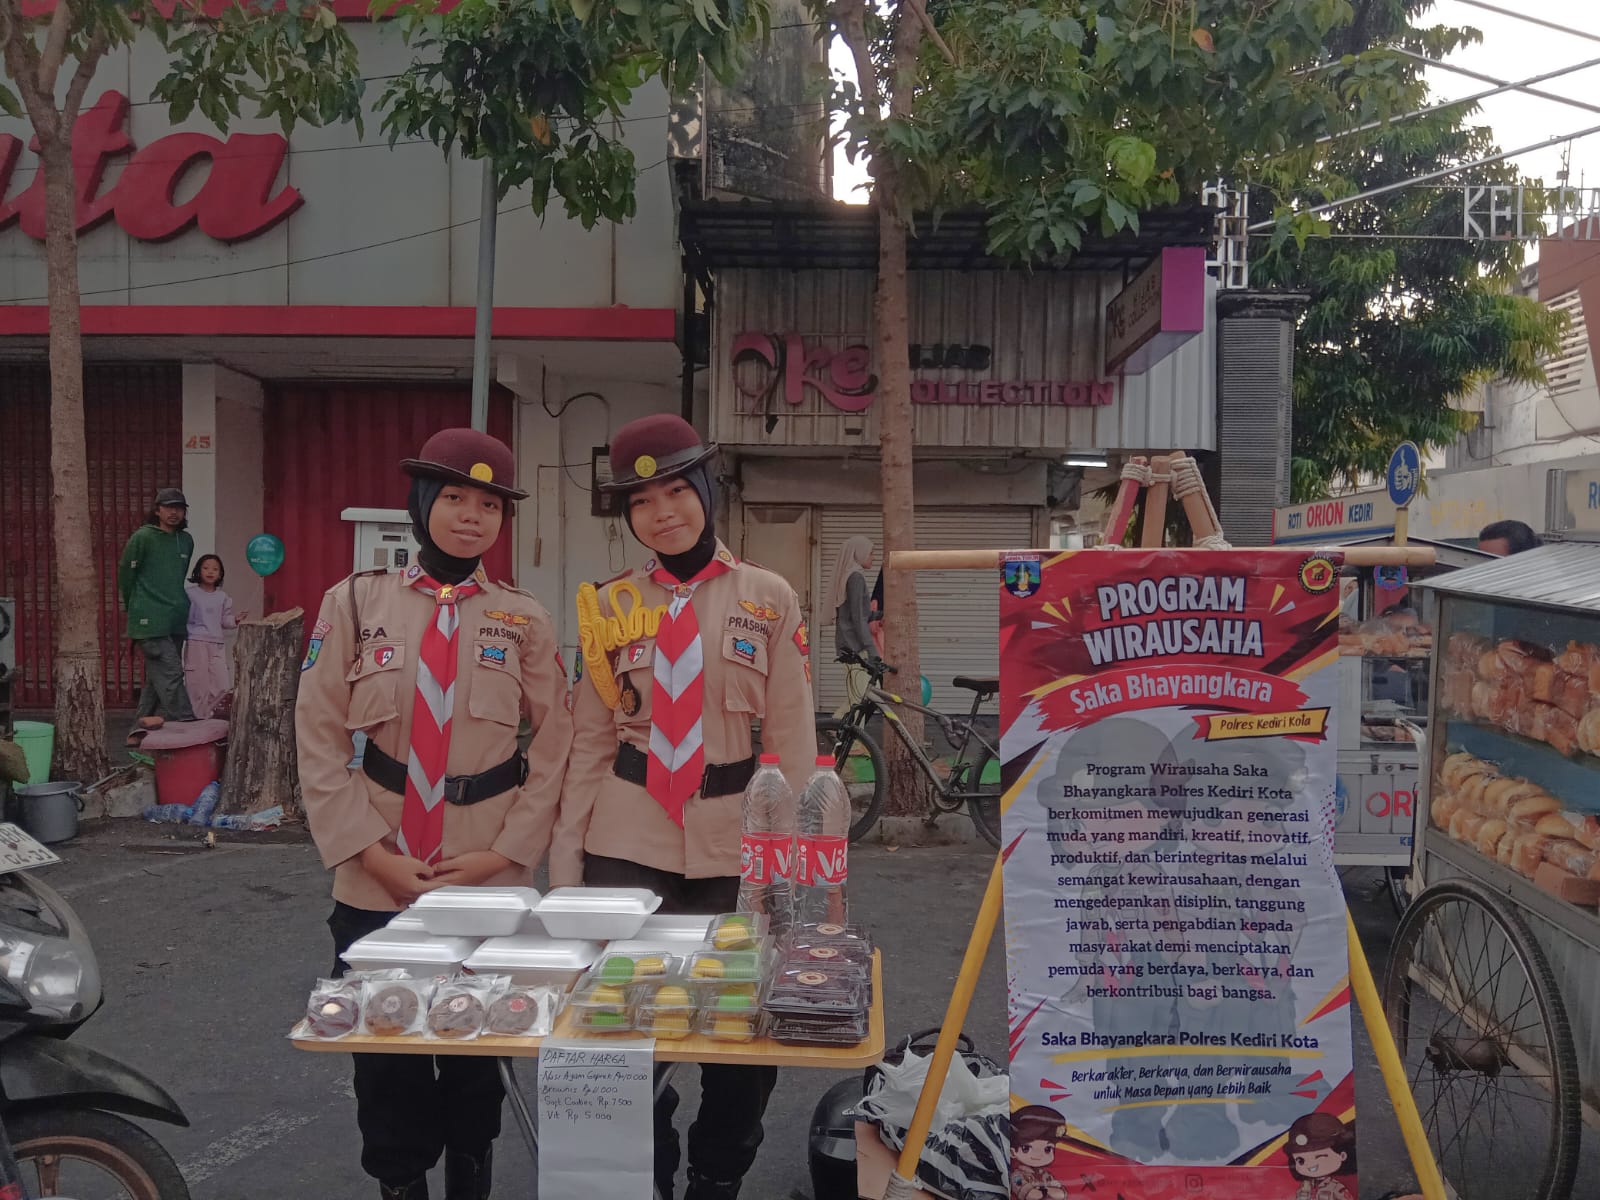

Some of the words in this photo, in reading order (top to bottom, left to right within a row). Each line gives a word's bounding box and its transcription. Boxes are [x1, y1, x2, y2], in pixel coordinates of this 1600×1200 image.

[0, 89, 305, 244] ta
[908, 343, 990, 371] IJAB
[910, 379, 1114, 407] OLLECTION
[186, 434, 211, 449] 45
[1288, 512, 1302, 529] ROTI
[1306, 501, 1344, 528] ORION
[1348, 502, 1374, 523] KEDIRI
[1097, 576, 1246, 622] PROGRAM
[359, 627, 388, 643] SA
[1083, 619, 1264, 666] WIRAUSAHA
[1070, 680, 1122, 714] Saka
[1126, 672, 1272, 704] Bhayangkara
[1220, 718, 1254, 730] Polres
[1257, 716, 1286, 729] Kediri
[1086, 763, 1146, 778] Program
[1150, 763, 1229, 777] Wirausaha
[1233, 764, 1268, 777] Saka
[1063, 785, 1156, 800] Bhayangkara
[1159, 785, 1204, 798] Polres
[1207, 785, 1254, 799] Kediri
[1258, 787, 1293, 800] Kota
[1366, 791, 1418, 817] OR
[1048, 807, 1143, 821] berkomitmen
[1147, 807, 1243, 823] mewujudkan
[1247, 811, 1309, 825] generasi
[1047, 830, 1087, 843] muda
[1091, 832, 1125, 846] yang
[1128, 829, 1188, 844] mandiri,
[1191, 829, 1245, 844] kreatif,
[1050, 851, 1122, 868] produktif,
[1125, 852, 1150, 865] dan
[1154, 851, 1247, 867] berintegritas
[1251, 853, 1307, 866] melalui
[1057, 874, 1124, 888] semangat
[1128, 874, 1242, 888] kewirausahaan,
[1246, 875, 1300, 890] dengan
[1054, 897, 1170, 911] mengedepankan
[1174, 896, 1231, 911] disiplin,
[1235, 898, 1305, 914] tanggung
[1065, 918, 1112, 933] jawab,
[1115, 919, 1149, 931] serta
[1153, 919, 1236, 933] pengabdian
[1240, 919, 1293, 934] kepada
[1069, 941, 1152, 955] masyarakat
[1155, 940, 1191, 953] demi
[1194, 941, 1291, 956] menciptakan
[1048, 964, 1105, 978] pemuda
[1108, 966, 1143, 979] yang
[1147, 963, 1209, 978] berdaya,
[1212, 964, 1282, 979] berkarya,
[1287, 965, 1314, 978] dan
[1087, 985, 1183, 998] berkontribusi
[1187, 985, 1218, 1000] bagi
[1222, 985, 1276, 1001] bangsa.
[1041, 1032, 1077, 1046] Saka
[1080, 1032, 1176, 1048] Bhayangkara
[1179, 1032, 1227, 1046] Polres
[1230, 1032, 1278, 1047] Kediri
[1281, 1033, 1319, 1049] Kota
[543, 1050, 586, 1064] DAFTAR
[590, 1052, 626, 1065] HARGA
[1071, 1066, 1137, 1082] Berkarakter,
[1139, 1065, 1190, 1080] Berkarya,
[1193, 1064, 1214, 1076] dan
[1216, 1062, 1292, 1076] Berwirausaha
[1093, 1086, 1122, 1100] untuk
[1124, 1085, 1152, 1098] Masa
[1154, 1084, 1186, 1098] Depan
[1188, 1085, 1214, 1098] yang
[1216, 1081, 1246, 1095] Lebih
[1248, 1081, 1272, 1094] Baik
[598, 1096, 609, 1109] Rp
[547, 1110, 560, 1120] Vit
[565, 1109, 579, 1124] Rp
